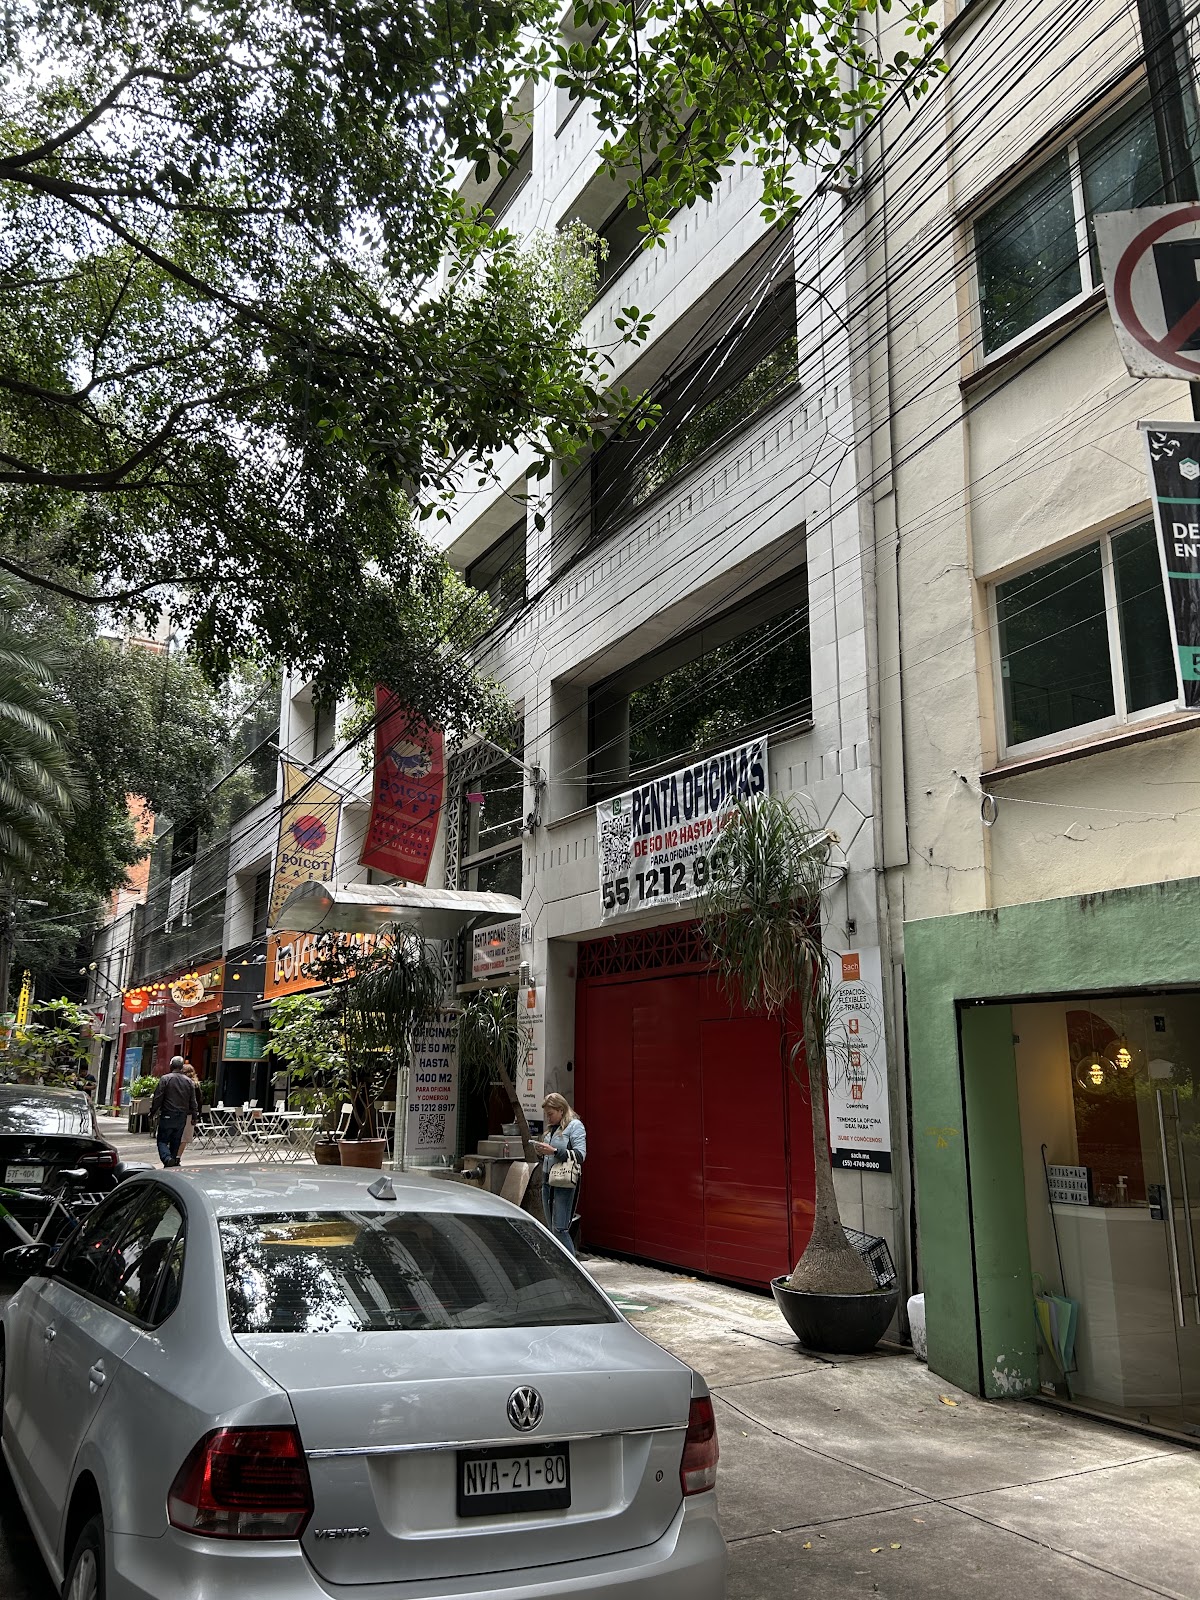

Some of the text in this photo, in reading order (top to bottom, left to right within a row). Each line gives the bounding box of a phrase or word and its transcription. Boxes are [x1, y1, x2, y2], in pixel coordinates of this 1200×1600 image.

[379, 779, 438, 805] BOICOT
[632, 741, 765, 838] RENTA OFICINAS
[634, 839, 648, 858] DE
[650, 834, 662, 853] 50
[665, 829, 678, 849] M2
[680, 817, 714, 845] HASTA
[650, 854, 669, 866] PARA
[670, 844, 698, 861] OFICINAS
[282, 853, 330, 871] BOICOT
[603, 876, 630, 909] 55
[636, 862, 687, 901] 1212
[843, 963, 859, 971] Sach
[840, 988, 866, 996] ESPACIOS
[838, 995, 867, 1003] FLEXIBLES
[415, 1044, 456, 1053] DE 50 M2
[420, 1058, 449, 1068] HASTA
[416, 1073, 453, 1083] 1400 M2
[410, 1104, 456, 1112] 55 1212 8917
[1050, 1168, 1082, 1178] CITAS AL
[466, 1456, 565, 1494] NVA-21-80
[314, 1526, 370, 1540] VENTO
